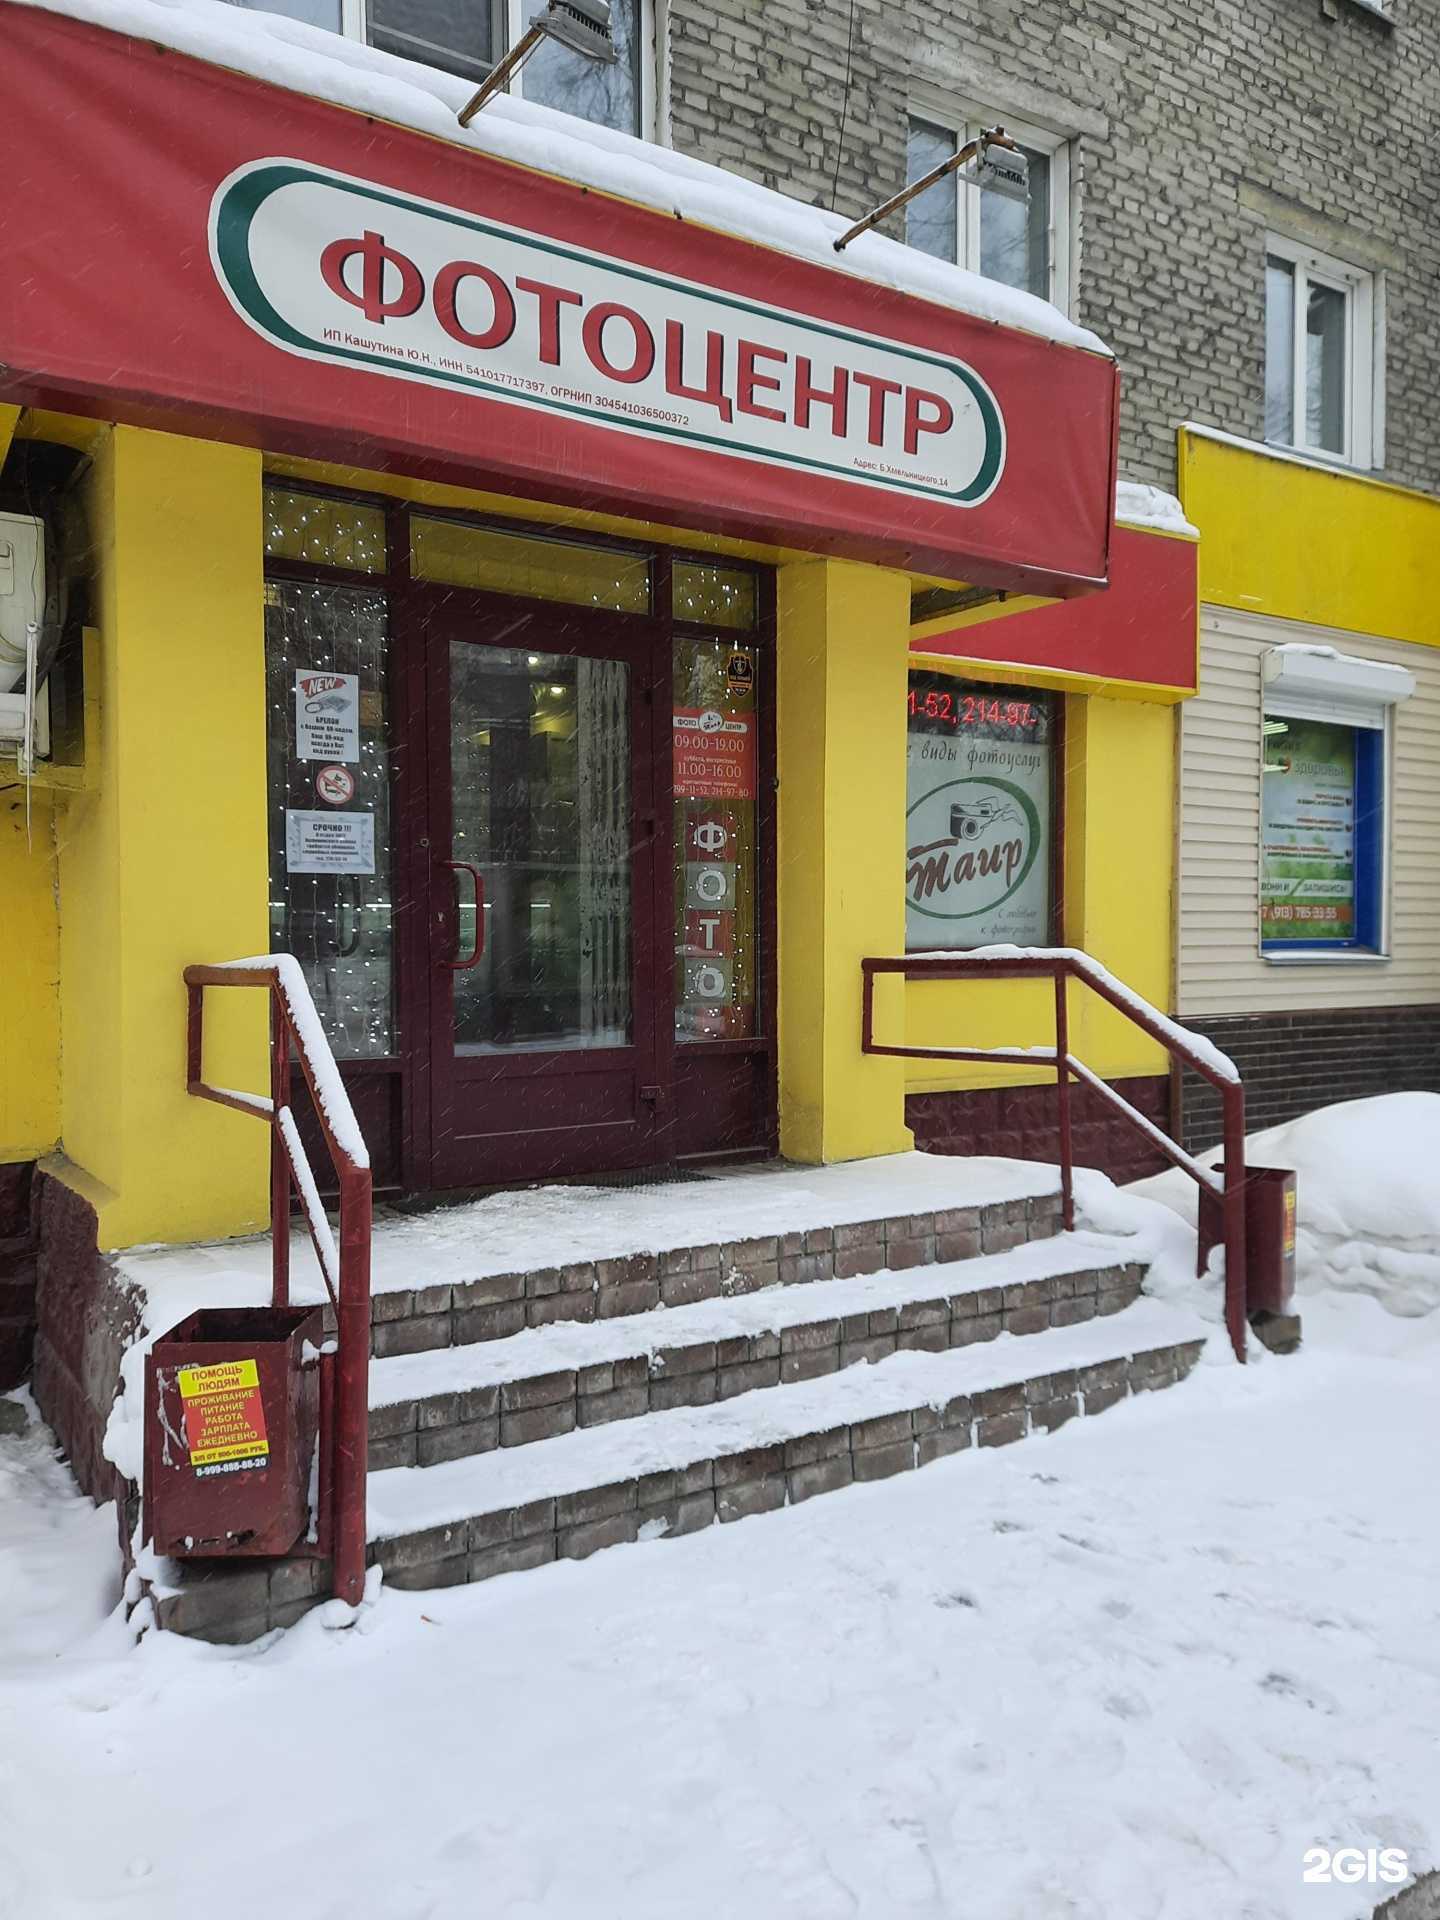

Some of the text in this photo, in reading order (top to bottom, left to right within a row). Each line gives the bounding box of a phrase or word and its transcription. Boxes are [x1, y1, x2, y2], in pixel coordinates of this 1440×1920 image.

[320, 230, 954, 456] ФОТОЦЕНТР
[323, 328, 341, 342] ИП
[345, 333, 404, 357] Кашутина
[439, 357, 463, 372] ИНН
[550, 386, 592, 405] ОГРНИП
[595, 396, 690, 426] 304541036500372
[308, 677, 337, 697] NEW
[921, 740, 958, 762] виды
[312, 823, 343, 832] СРОЧНО
[192, 1366, 243, 1381] ПОМОЩЬ
[198, 1378, 240, 1392] ЛЮДЯМ
[187, 1390, 255, 1407] ПРОЖИВАНИЕ
[200, 1401, 245, 1416] ПИТАНИЕ
[205, 1413, 243, 1425] РАБОТА
[201, 1422, 250, 1435] ЗАРПЛАТА
[197, 1431, 257, 1447] ЕЖЕДНЕВНО
